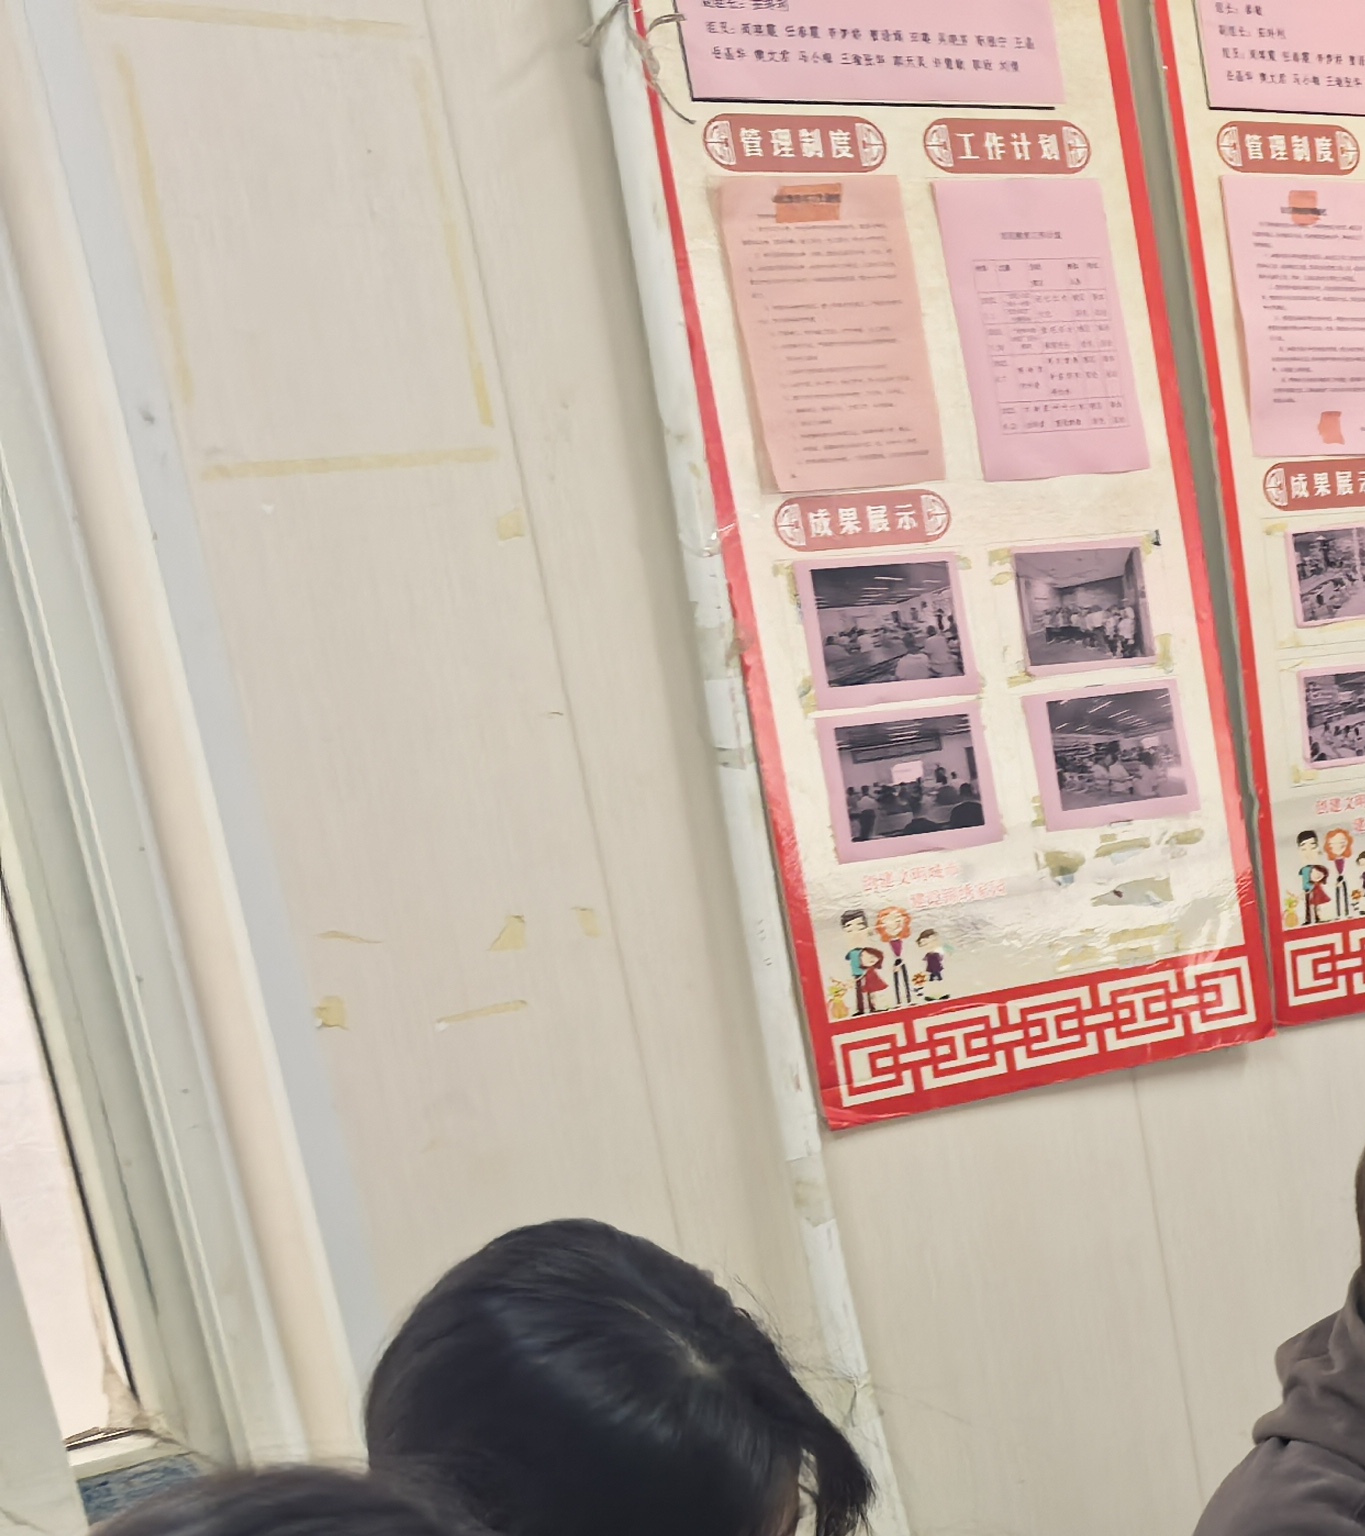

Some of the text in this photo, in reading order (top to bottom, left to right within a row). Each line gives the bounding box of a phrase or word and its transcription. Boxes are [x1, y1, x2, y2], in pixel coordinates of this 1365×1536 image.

[739, 127, 855, 161] 管理制度
[956, 132, 1061, 163] 工作计划
[1244, 133, 1335, 164] 管理制度
[808, 503, 919, 538] 成果展示
